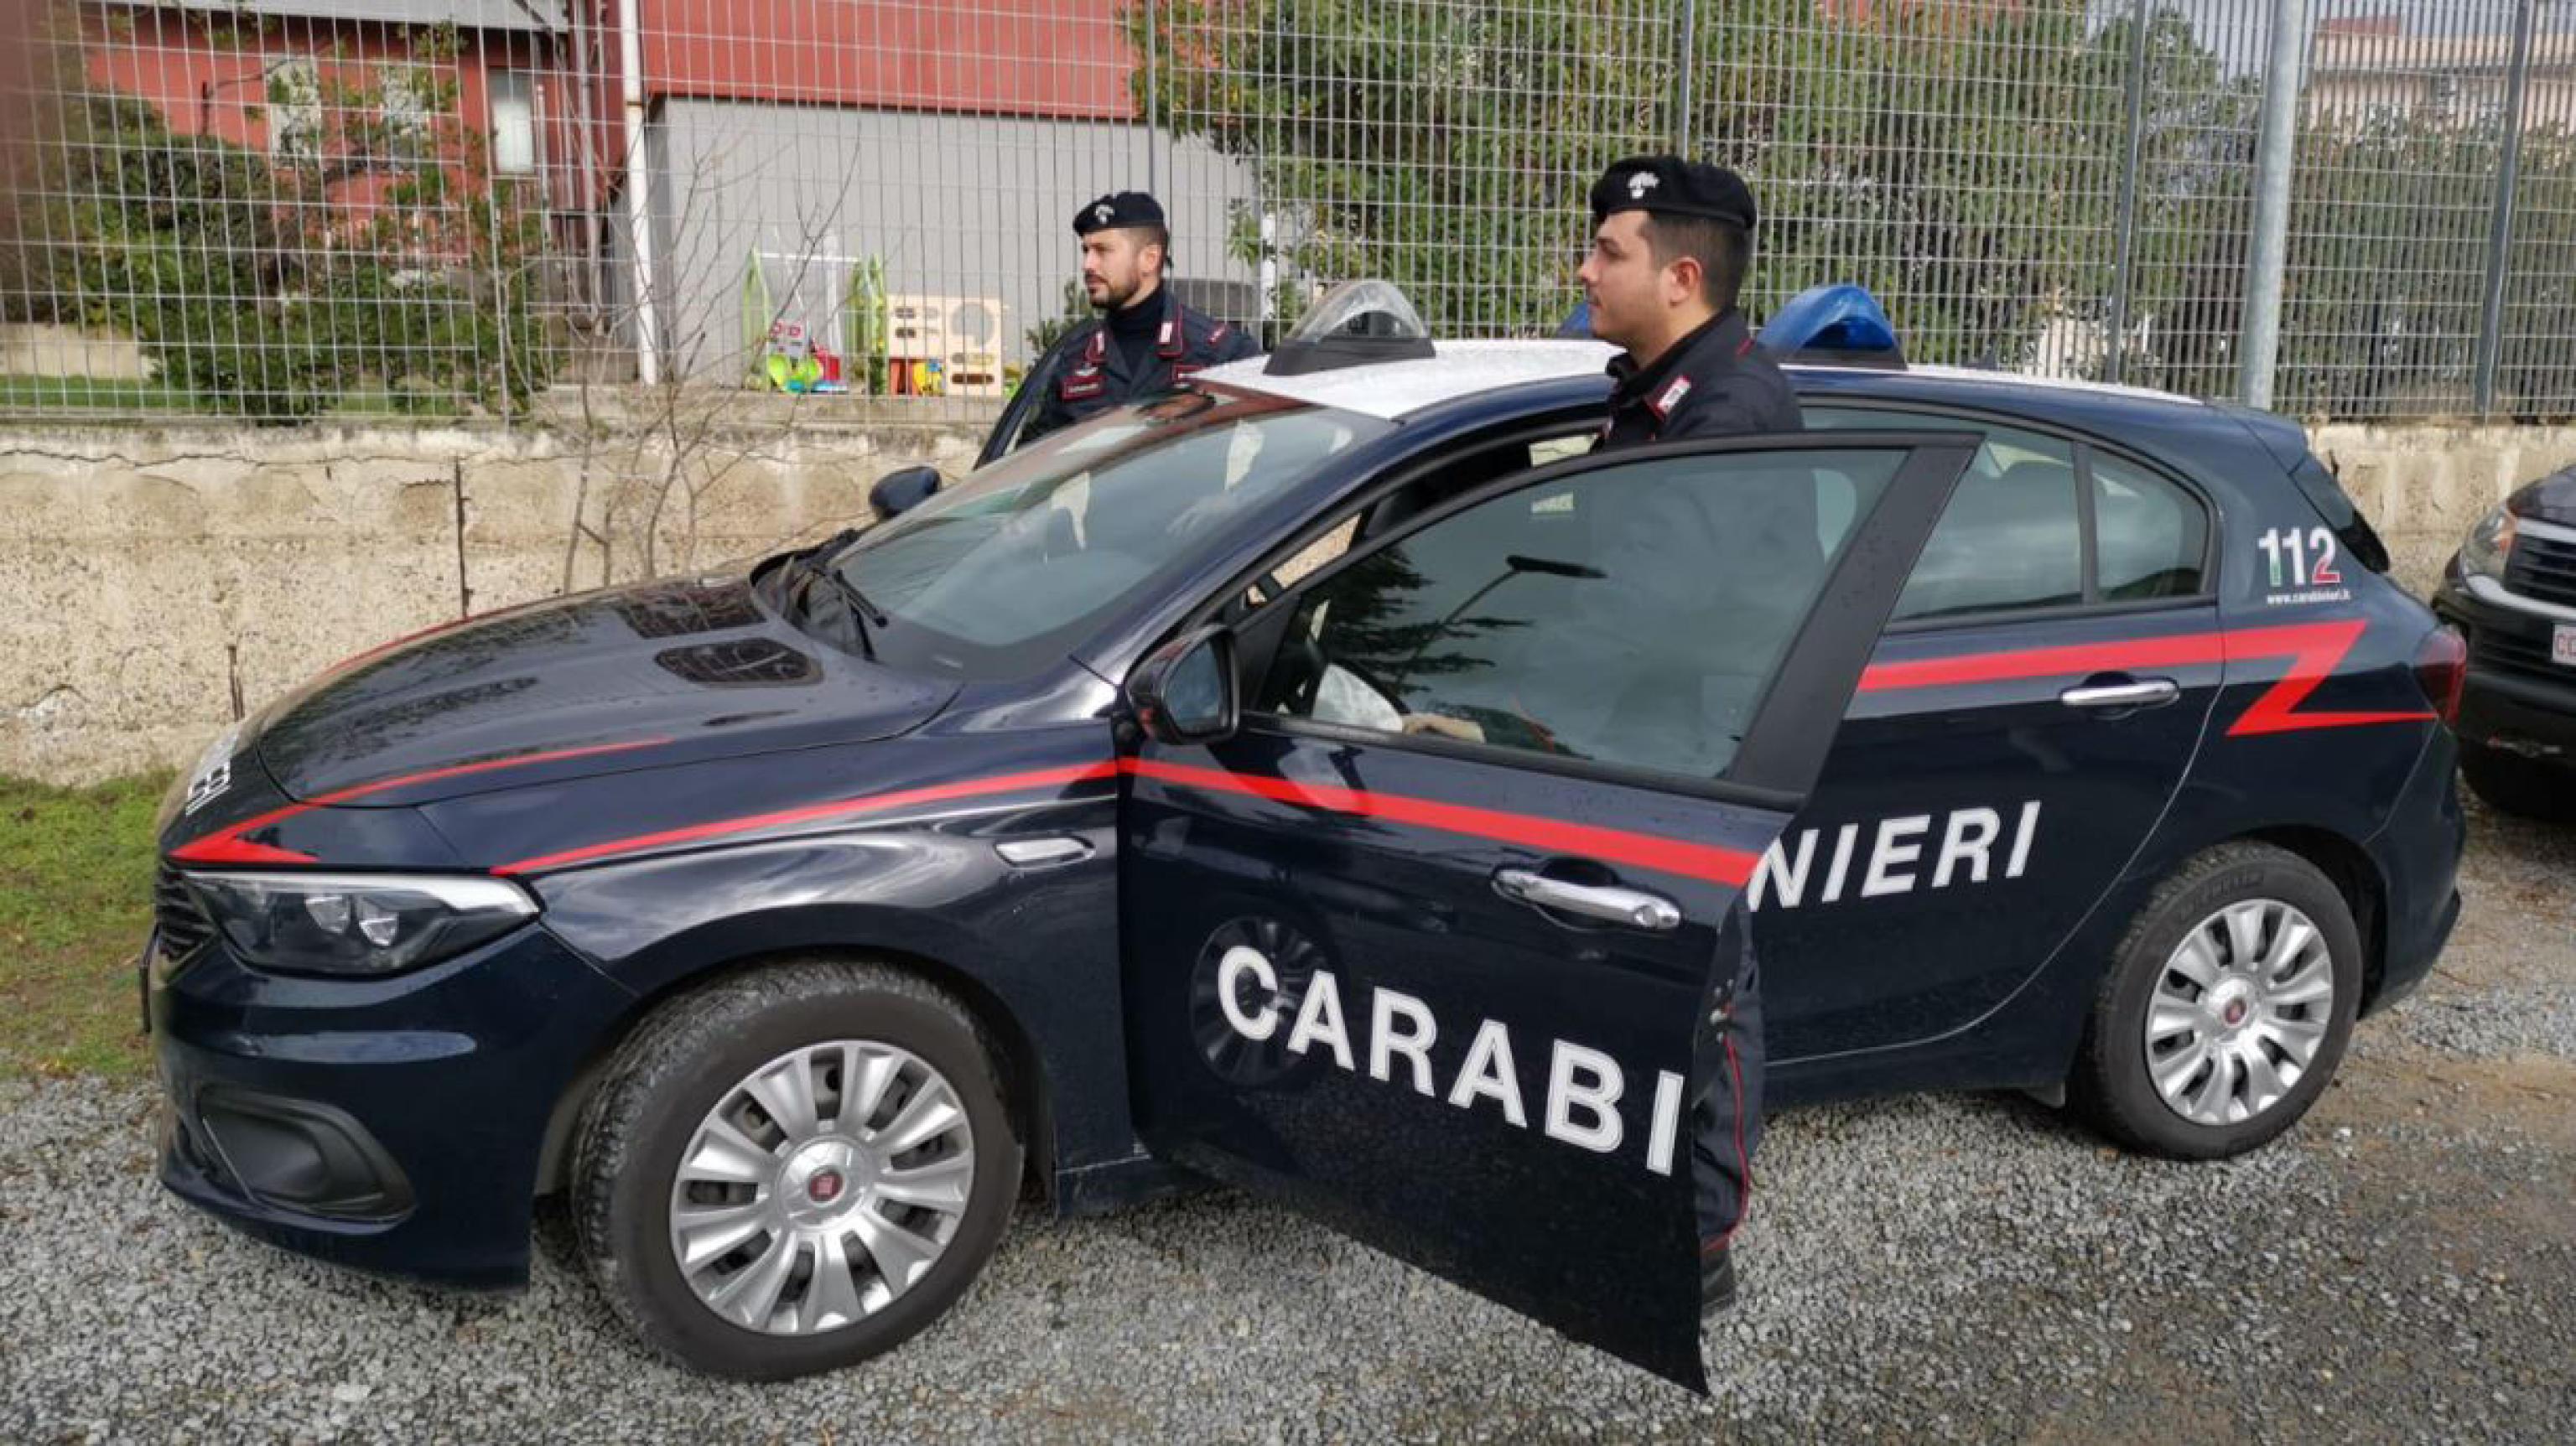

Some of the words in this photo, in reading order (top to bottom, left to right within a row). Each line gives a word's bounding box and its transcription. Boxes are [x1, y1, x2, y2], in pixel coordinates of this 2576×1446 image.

[2257, 526, 2340, 586] 112
[1747, 800, 2040, 912] NIERI
[1218, 945, 1684, 1177] CARABI
